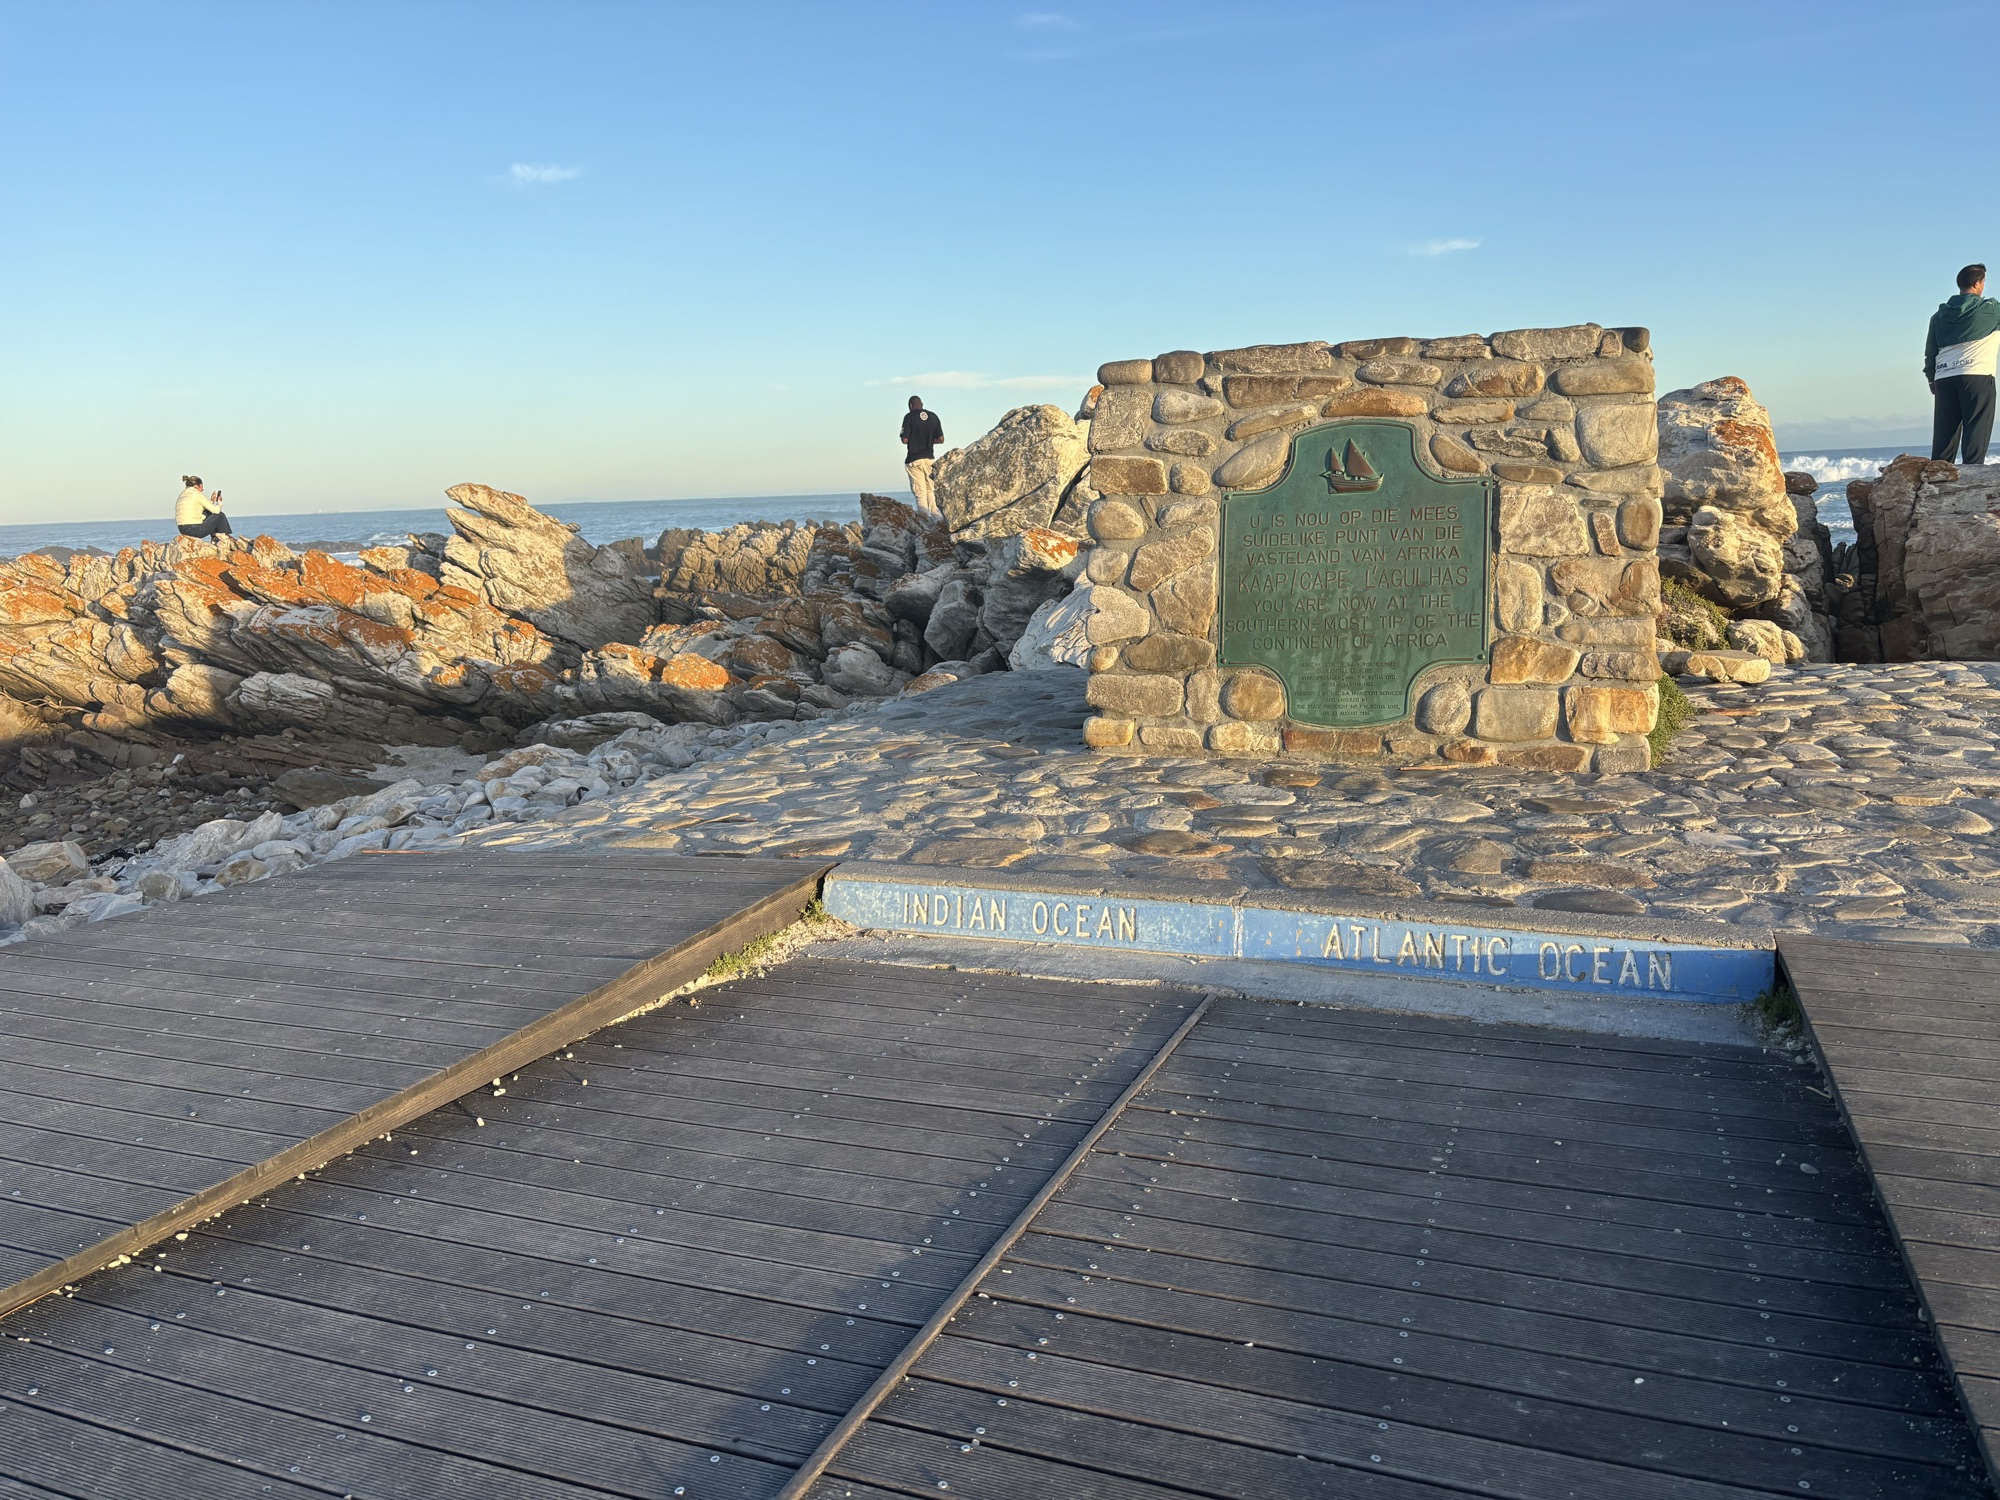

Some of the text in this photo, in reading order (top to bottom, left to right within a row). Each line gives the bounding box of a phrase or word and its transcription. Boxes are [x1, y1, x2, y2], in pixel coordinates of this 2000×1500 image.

[1250, 505, 1458, 528] U IS NOU OP DIE MEES
[1243, 525, 1463, 547] SUIDELIKE PUNT VAN DIE
[1246, 545, 1461, 566] VASTELAND VAN AFRIKA
[1238, 564, 1469, 595] KAAP/CAPE L'AGULHAS
[1253, 593, 1452, 613] YOU ARE NOW AT THE
[1225, 612, 1481, 633] SOUTHERN-MOST TIP OF THE
[1252, 631, 1448, 650] CONTINENT OF AFRICA
[903, 893, 1137, 942] INDIAN OCEAN
[1322, 923, 1672, 990] ATLANTIC OCEAN
